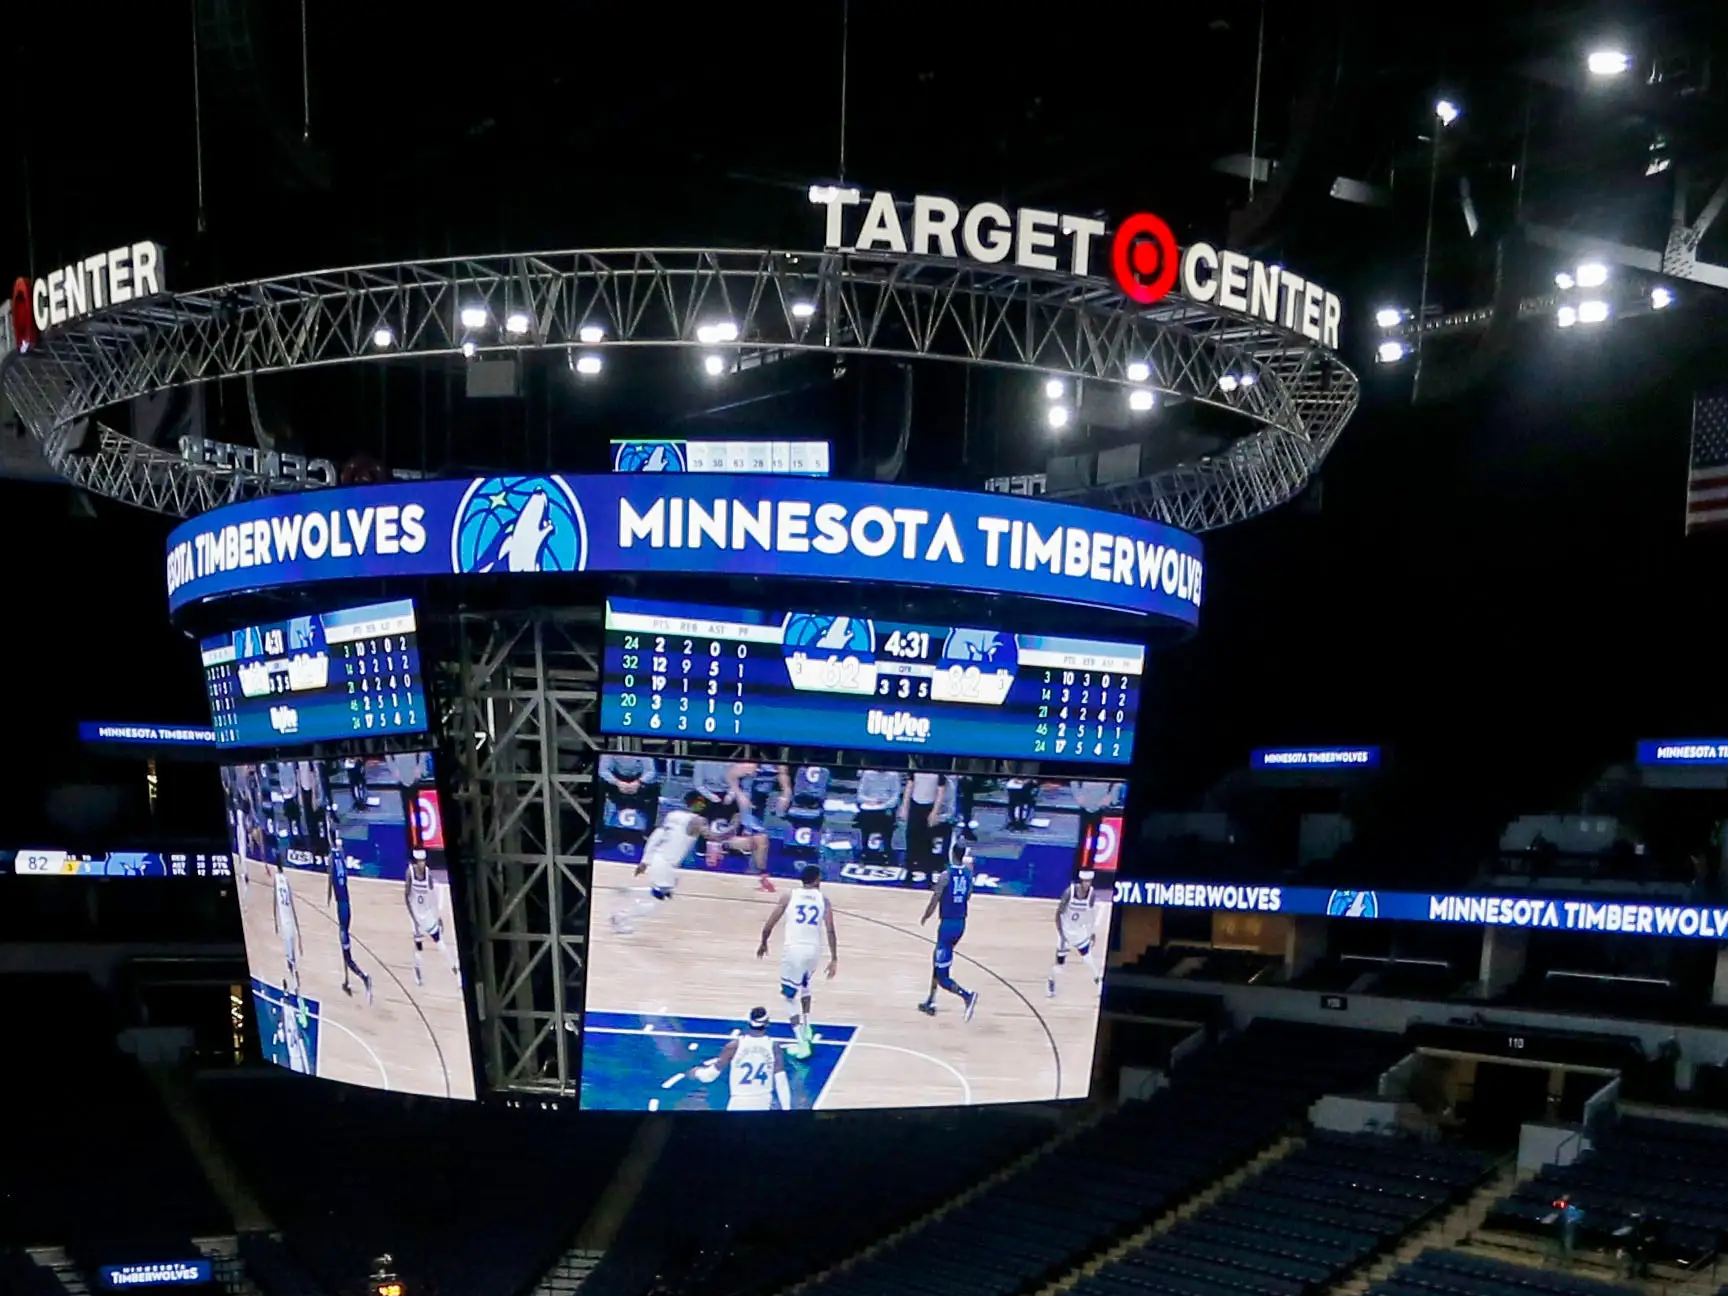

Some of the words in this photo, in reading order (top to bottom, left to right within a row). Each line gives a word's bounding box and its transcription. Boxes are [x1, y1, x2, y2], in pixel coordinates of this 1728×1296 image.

[808, 185, 1106, 277] TARGET
[1181, 240, 1342, 351] CENTER
[32, 239, 160, 332] CENTER
[618, 496, 965, 563] MINNESOTA
[194, 503, 427, 578] TIMBERWOLVES
[653, 620, 670, 631] PTS
[708, 624, 725, 635] AST
[370, 640, 377, 654] 3
[624, 636, 639, 650] 24
[655, 637, 666, 653] 2
[683, 640, 693, 655] 2
[710, 641, 721, 656] 0
[737, 644, 747, 659] 0
[884, 630, 929, 659] 4:31
[622, 655, 639, 670] 32
[653, 656, 667, 673] 12
[682, 660, 691, 674] 9
[709, 662, 720, 677] 5
[738, 664, 744, 678] 1
[625, 675, 634, 688] 0
[652, 675, 667, 691] 19
[683, 678, 687, 692] 1
[707, 680, 718, 696] 3
[737, 683, 742, 697] 1
[880, 679, 889, 695] 3
[898, 679, 910, 698] 3
[918, 683, 928, 698] 5
[1044, 672, 1051, 684] 3
[1062, 672, 1075, 686] 10
[1083, 673, 1090, 686] 3
[1101, 674, 1110, 688] 0
[1120, 677, 1128, 690] 2
[621, 693, 637, 707] 20
[651, 694, 661, 710] 3
[680, 698, 688, 711] 3
[709, 699, 715, 713] 1
[734, 701, 743, 715] 0
[1041, 689, 1051, 701] 14
[1061, 689, 1070, 703] 3
[1081, 691, 1089, 704] 2
[1101, 692, 1107, 704] 1
[1118, 694, 1126, 707] 2
[622, 712, 632, 726] 5
[650, 714, 661, 729] 6
[678, 717, 687, 730] 3
[705, 717, 716, 732] 0
[734, 720, 739, 734] 1
[1038, 706, 1048, 718] 21
[1059, 707, 1069, 720] 4
[1079, 709, 1087, 721] 2
[1097, 709, 1107, 723] 4
[1116, 711, 1124, 723] 0
[98, 726, 158, 741] MINNESOTA
[1035, 723, 1048, 736] 46
[1057, 724, 1066, 737] 2
[1077, 726, 1085, 738] 5
[1097, 725, 1103, 739] 1
[1116, 728, 1120, 740] 1
[1035, 740, 1046, 752] 24
[1075, 742, 1083, 755] 5
[1093, 742, 1102, 756] 4
[1112, 744, 1119, 757] 2
[1264, 752, 1308, 765] MINNESOTA
[1306, 751, 1369, 764] TIMBERWOLVES
[1656, 744, 1717, 759] MINNESOTA
[27, 856, 49, 871] 82
[1144, 882, 1282, 913] TIMBERWOLVES
[795, 905, 820, 926] 32
[1427, 894, 1561, 927] MINNESOTA
[1507, 1036, 1525, 1049] 110
[739, 1062, 769, 1085] 24
[110, 1266, 199, 1284] TIMBERWOLVES
[122, 1263, 186, 1274] MINNESOTA
